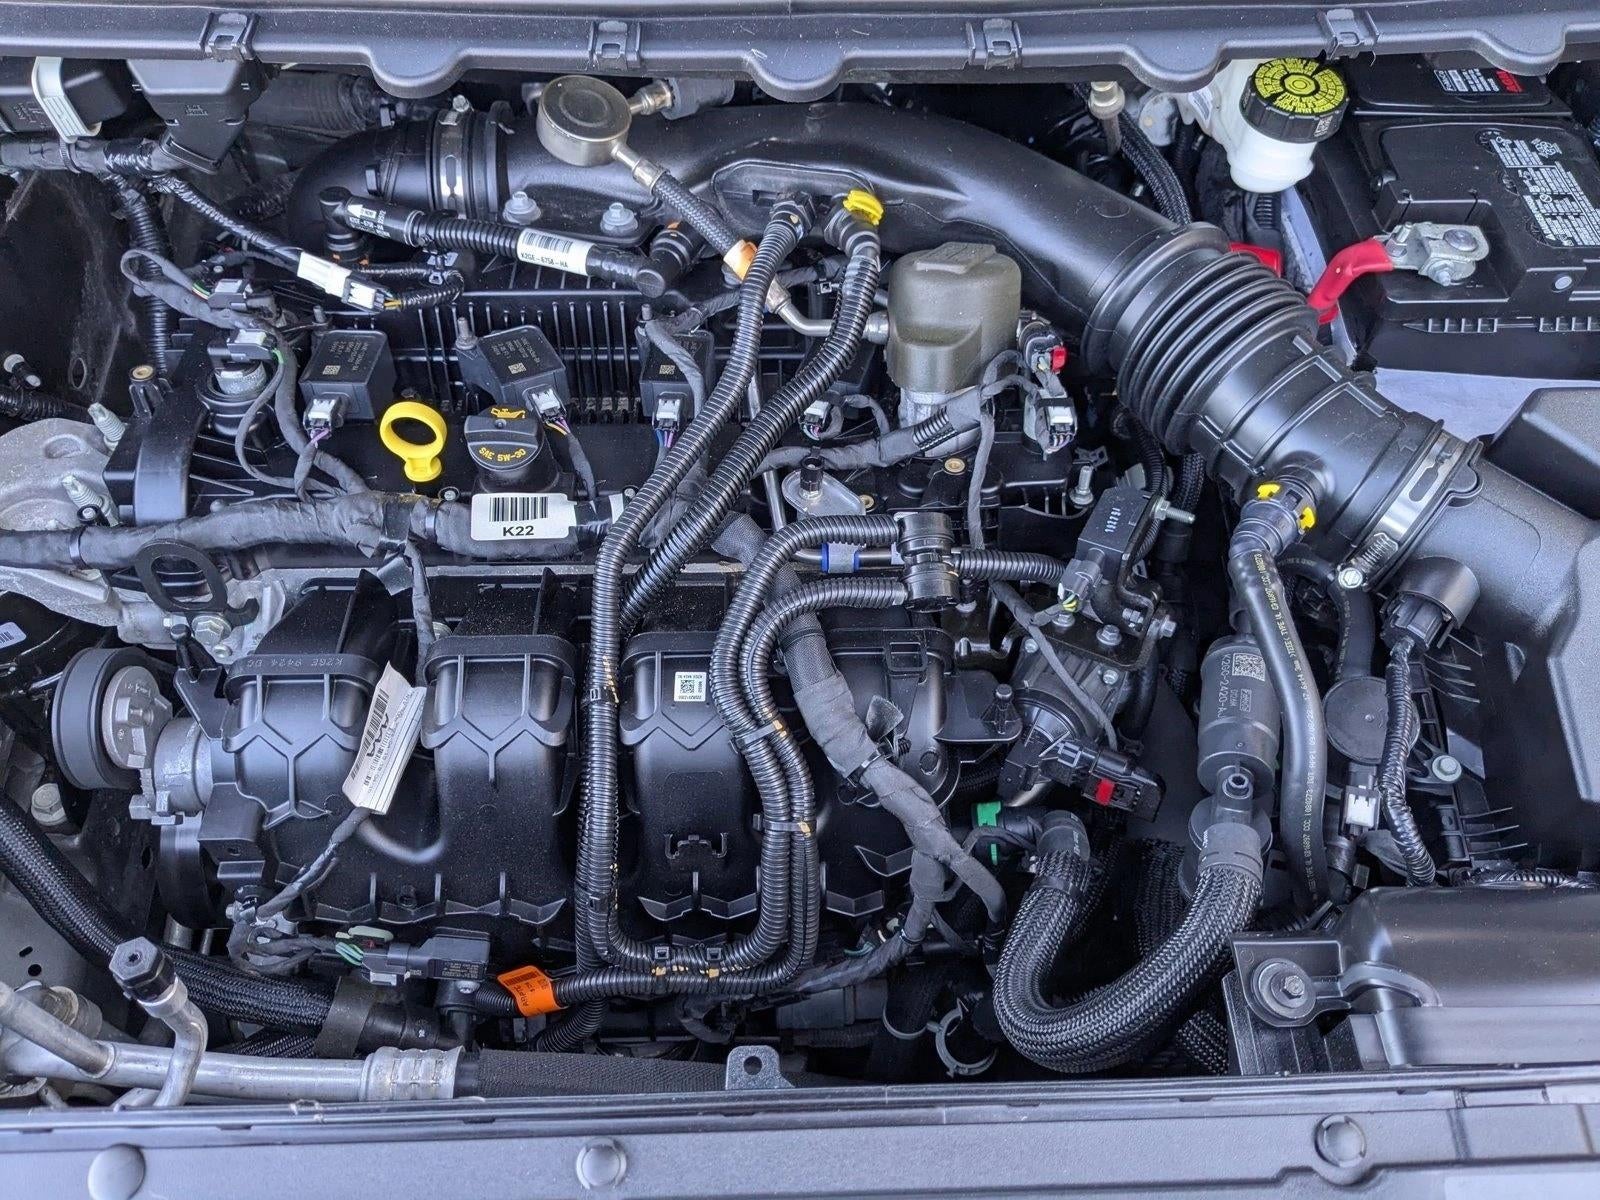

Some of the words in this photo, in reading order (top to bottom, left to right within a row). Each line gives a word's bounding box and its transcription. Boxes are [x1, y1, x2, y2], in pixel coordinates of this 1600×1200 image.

[479, 447, 495, 460] SAE
[497, 448, 526, 462] 5W-30
[503, 525, 535, 537] K22
